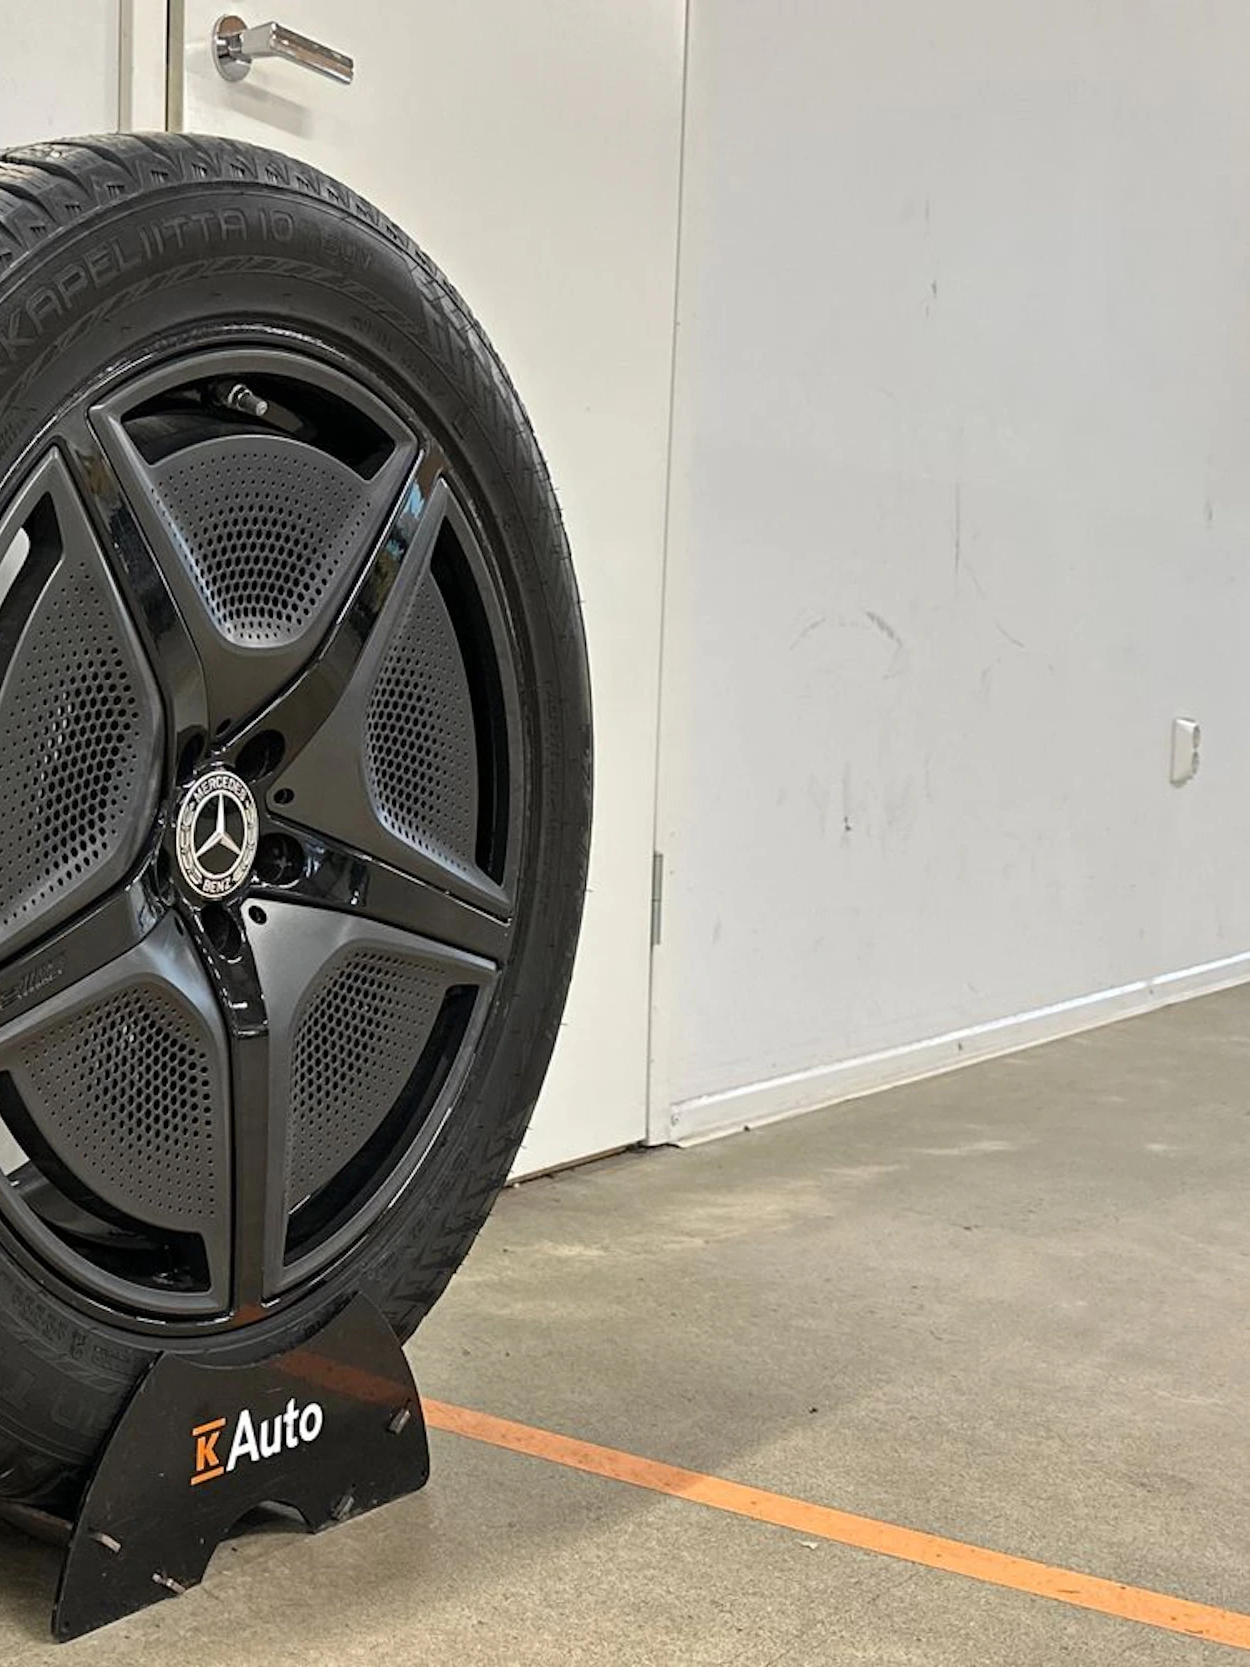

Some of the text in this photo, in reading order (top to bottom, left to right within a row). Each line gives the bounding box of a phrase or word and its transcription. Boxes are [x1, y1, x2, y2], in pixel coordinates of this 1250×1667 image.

[260, 209, 295, 242] 10
[193, 775, 248, 804] MERCEDES
[201, 876, 233, 894] BENZ
